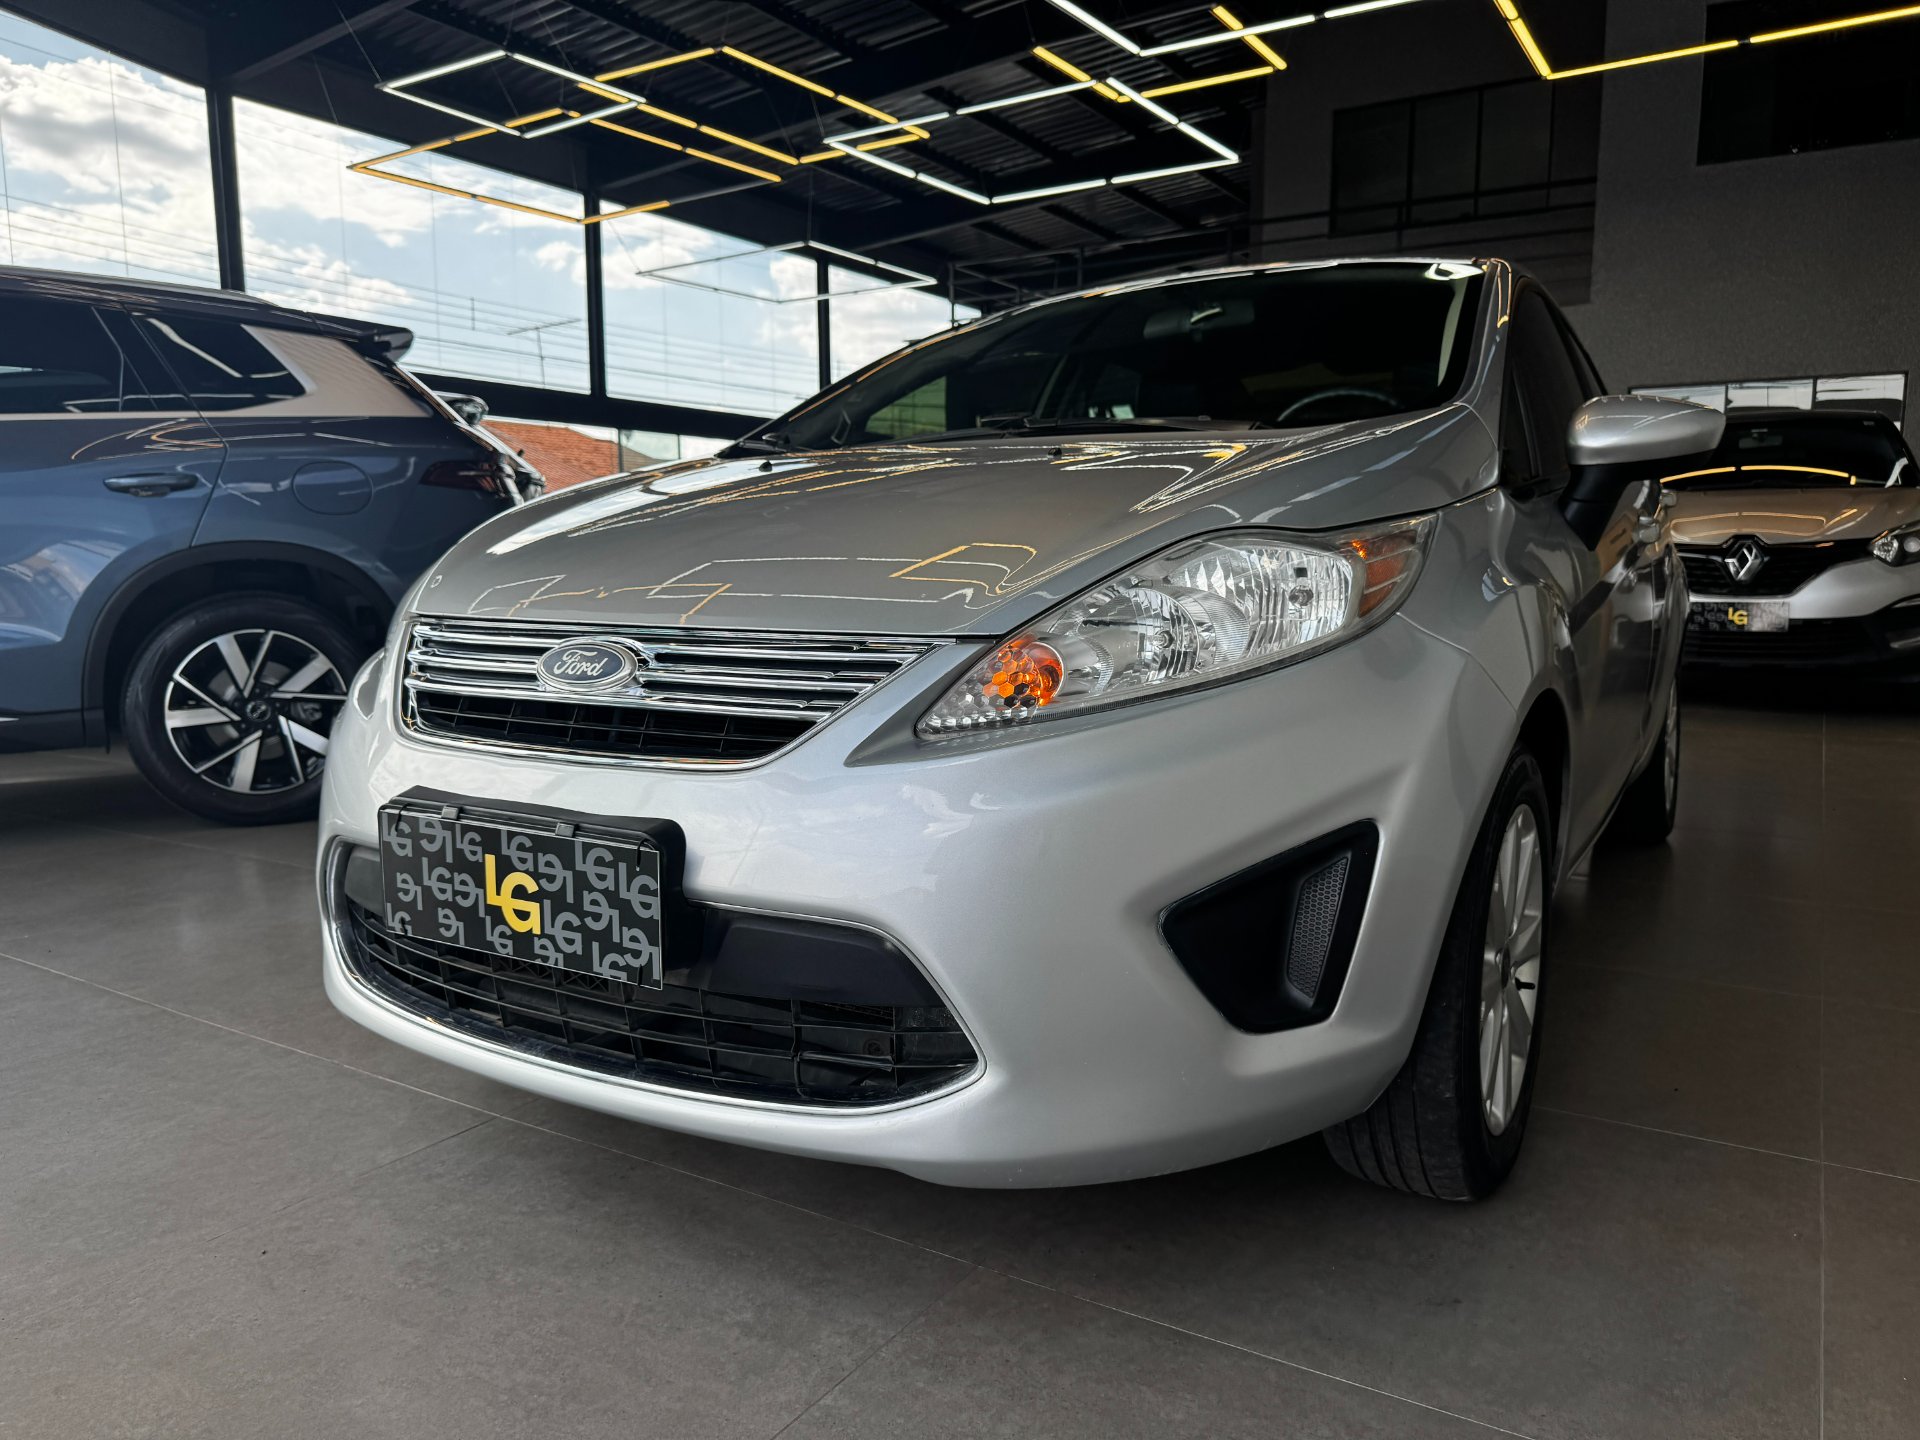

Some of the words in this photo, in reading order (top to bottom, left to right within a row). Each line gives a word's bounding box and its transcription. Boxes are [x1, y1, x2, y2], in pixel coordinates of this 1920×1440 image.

[1728, 607, 1748, 625] LG
[553, 650, 608, 676] Ford
[485, 854, 541, 934] LG
